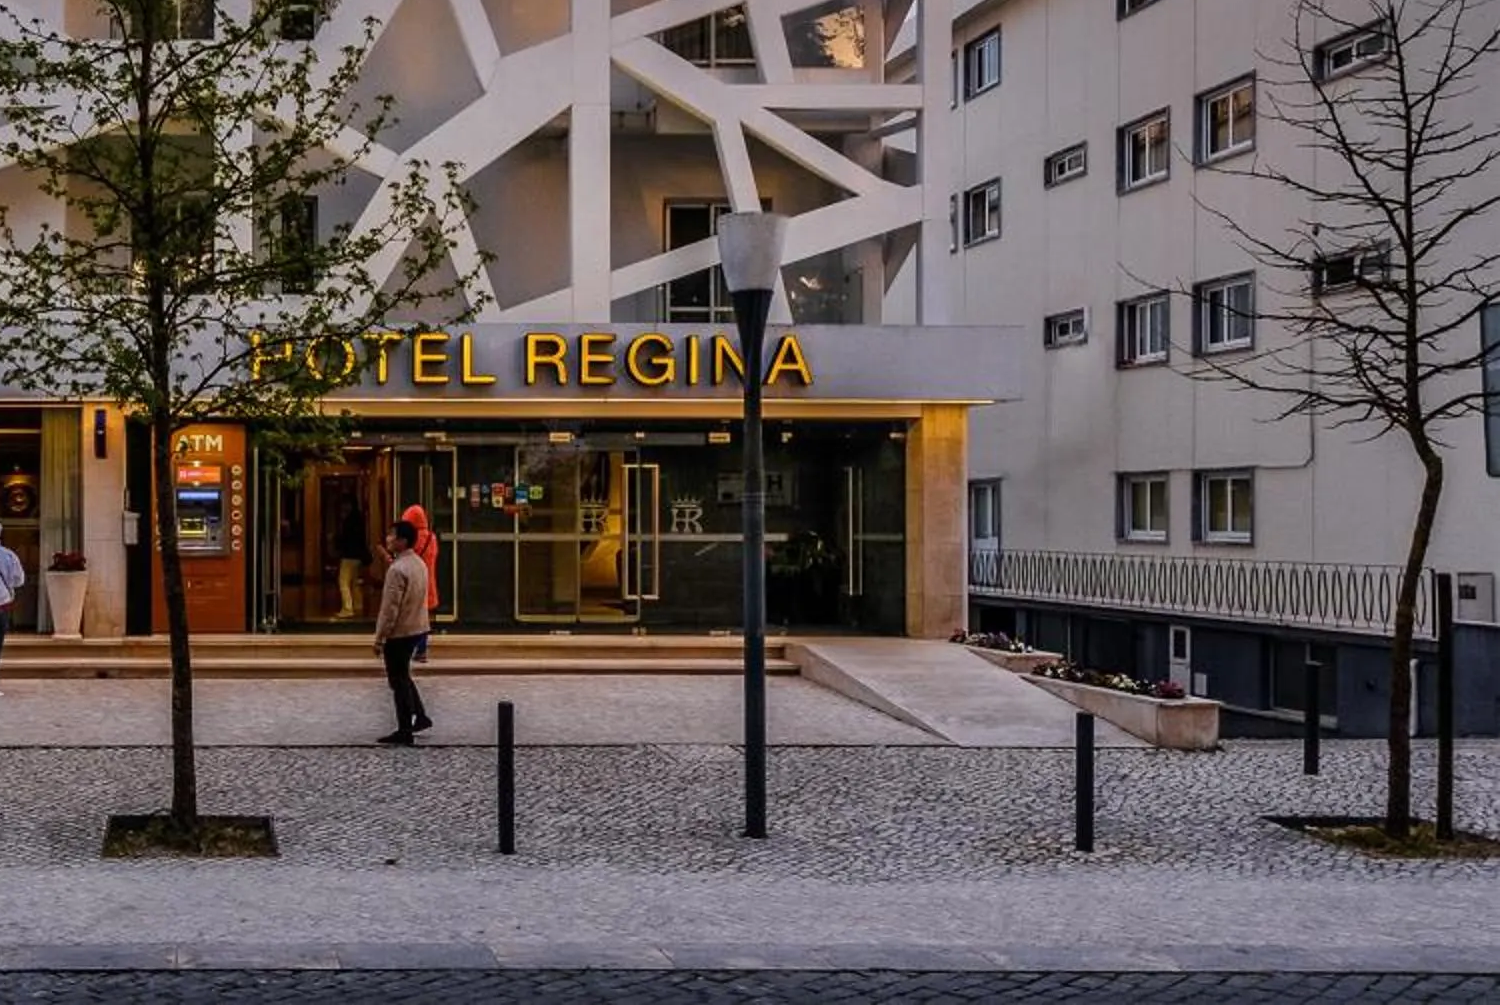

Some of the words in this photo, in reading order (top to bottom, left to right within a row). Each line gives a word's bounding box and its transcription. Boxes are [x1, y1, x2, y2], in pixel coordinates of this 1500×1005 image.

[250, 331, 497, 384] HOTEL
[525, 333, 813, 386] REGINA
[175, 434, 223, 452] ATM
